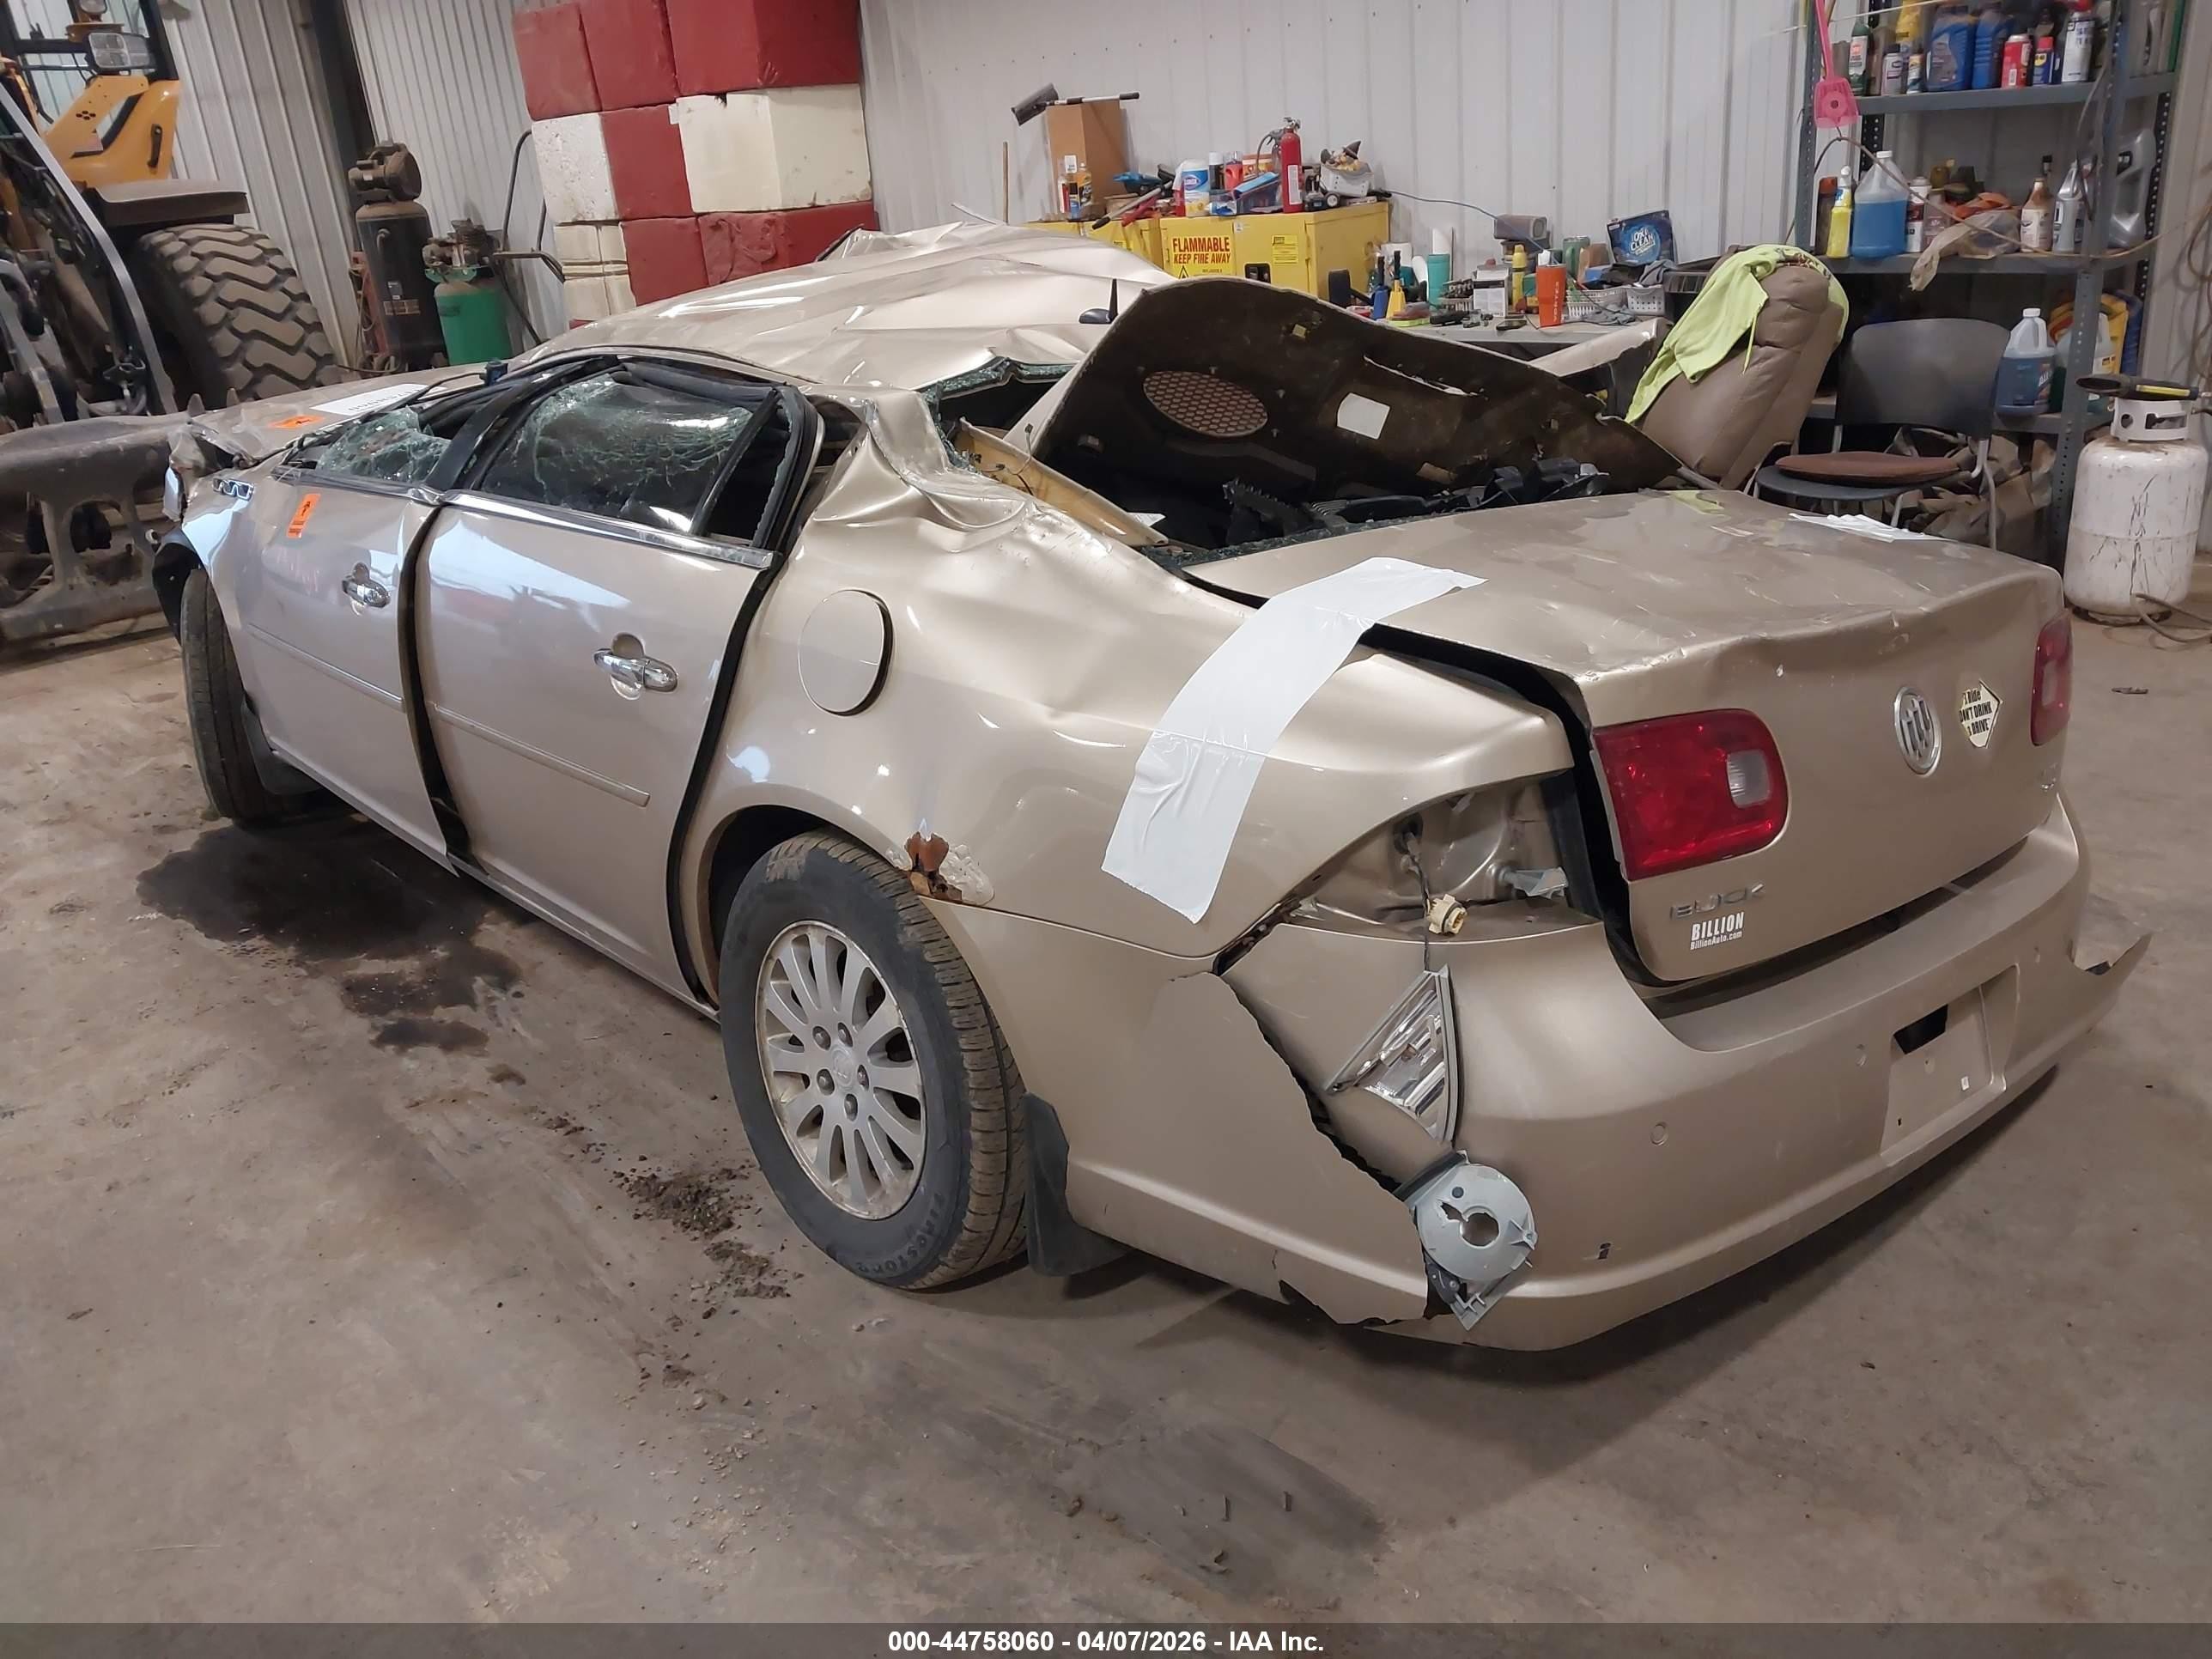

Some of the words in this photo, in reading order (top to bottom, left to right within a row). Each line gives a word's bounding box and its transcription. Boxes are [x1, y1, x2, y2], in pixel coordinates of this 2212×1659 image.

[1172, 237, 1230, 252] FLAMMABLE
[1630, 233, 1654, 252] CLEAN
[1173, 253, 1191, 264] KEEP
[1193, 252, 1208, 264] FIRE
[1210, 252, 1231, 264] AWAY
[1973, 701, 1993, 718] DRINK
[1669, 884, 1764, 920] BUICK
[1691, 911, 1745, 941] BILLION
[1690, 931, 1743, 951] BillionAuto.com
